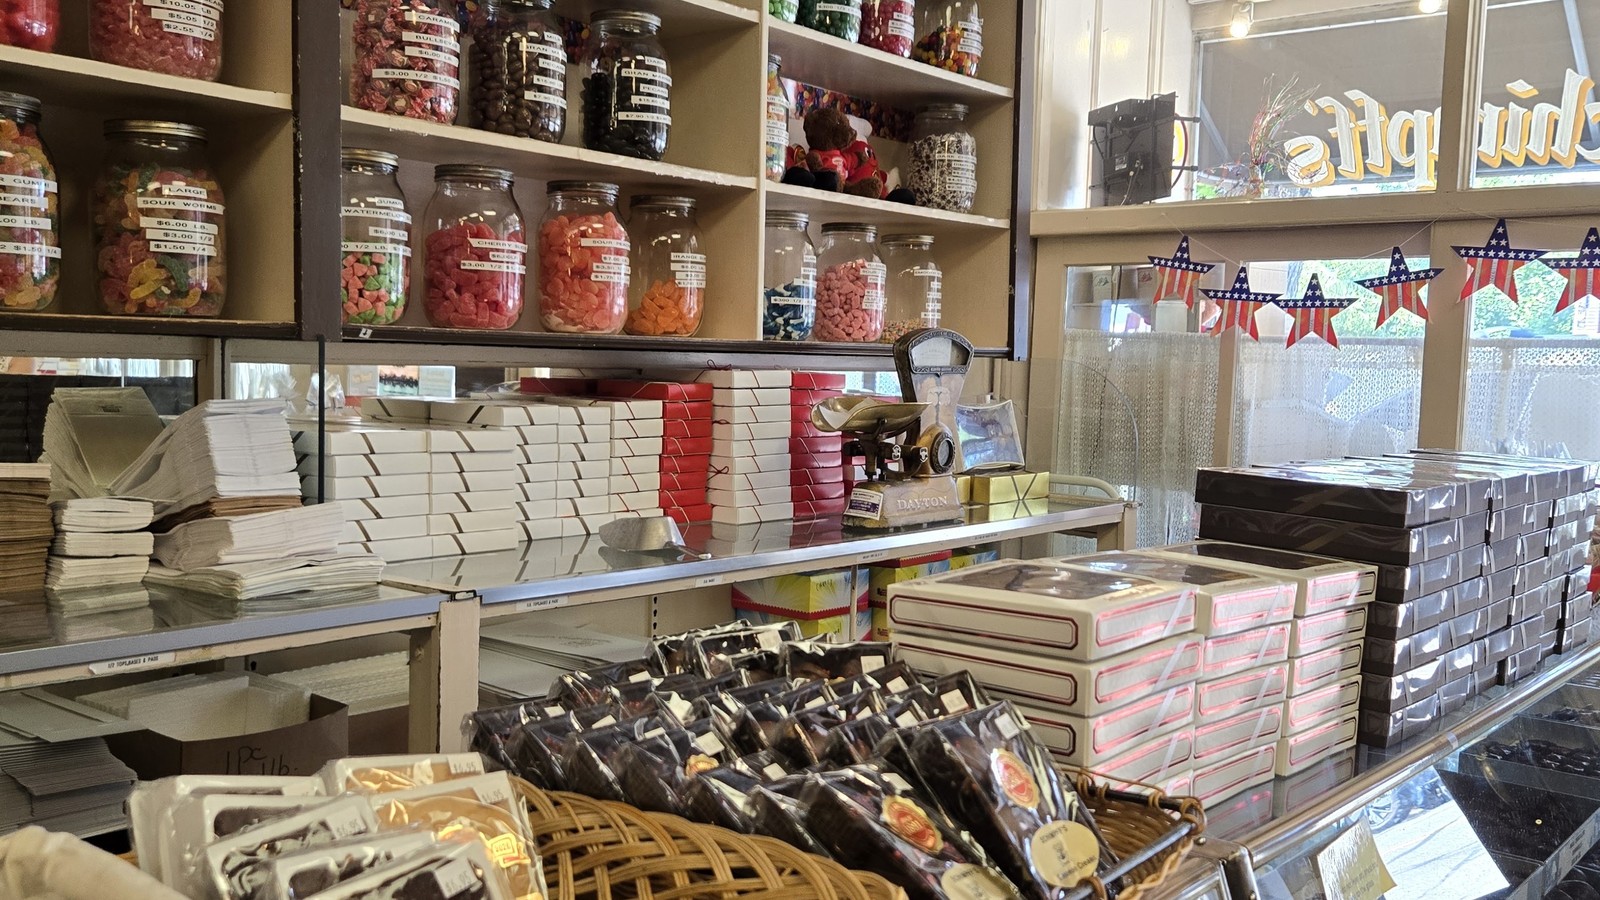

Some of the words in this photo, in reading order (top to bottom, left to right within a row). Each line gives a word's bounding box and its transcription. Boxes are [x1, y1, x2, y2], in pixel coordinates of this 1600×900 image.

[168, 12, 197, 23] $5.05
[202, 19, 215, 27] 1/2
[164, 23, 194, 33] $2.55
[168, 187, 206, 196] LARGE
[182, 203, 217, 211] WORMS
[156, 220, 188, 228] $6.00
[163, 231, 193, 239] $3.00
[13, 244, 42, 252] $1.50
[153, 243, 186, 251] $1.50
[477, 240, 511, 248] CHERRY
[896, 495, 949, 510] DAYTON
